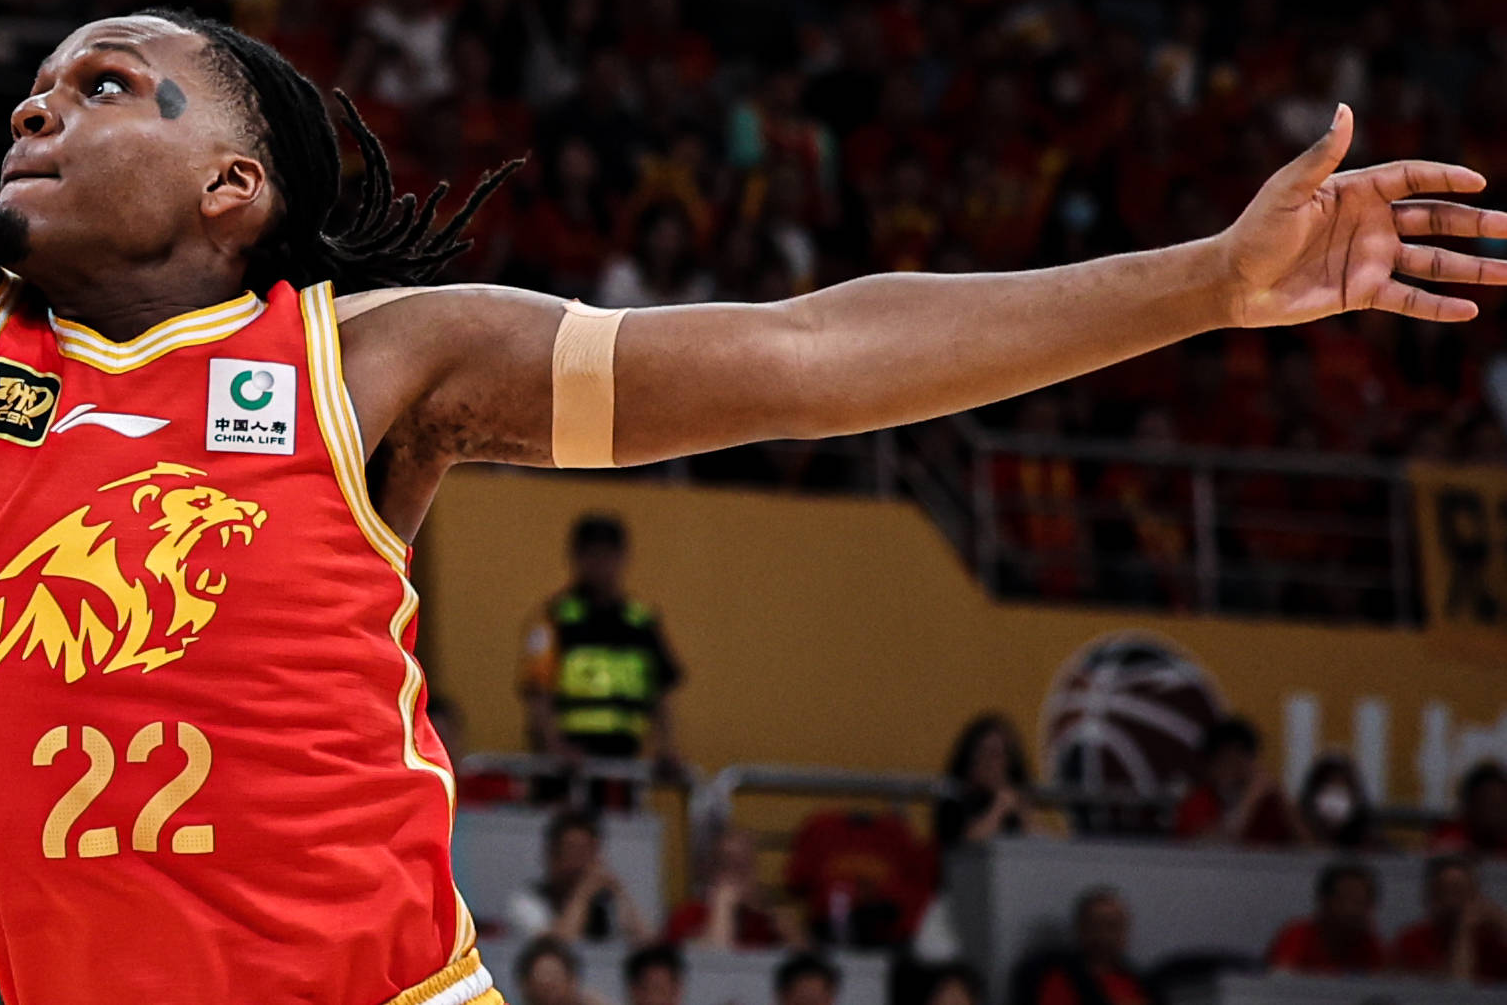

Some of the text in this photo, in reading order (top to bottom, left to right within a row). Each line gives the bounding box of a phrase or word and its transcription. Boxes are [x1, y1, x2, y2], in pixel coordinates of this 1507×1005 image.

[214, 417, 287, 435] 中国人寿
[214, 433, 286, 446] CHINA LIFE
[32, 721, 215, 860] 22
